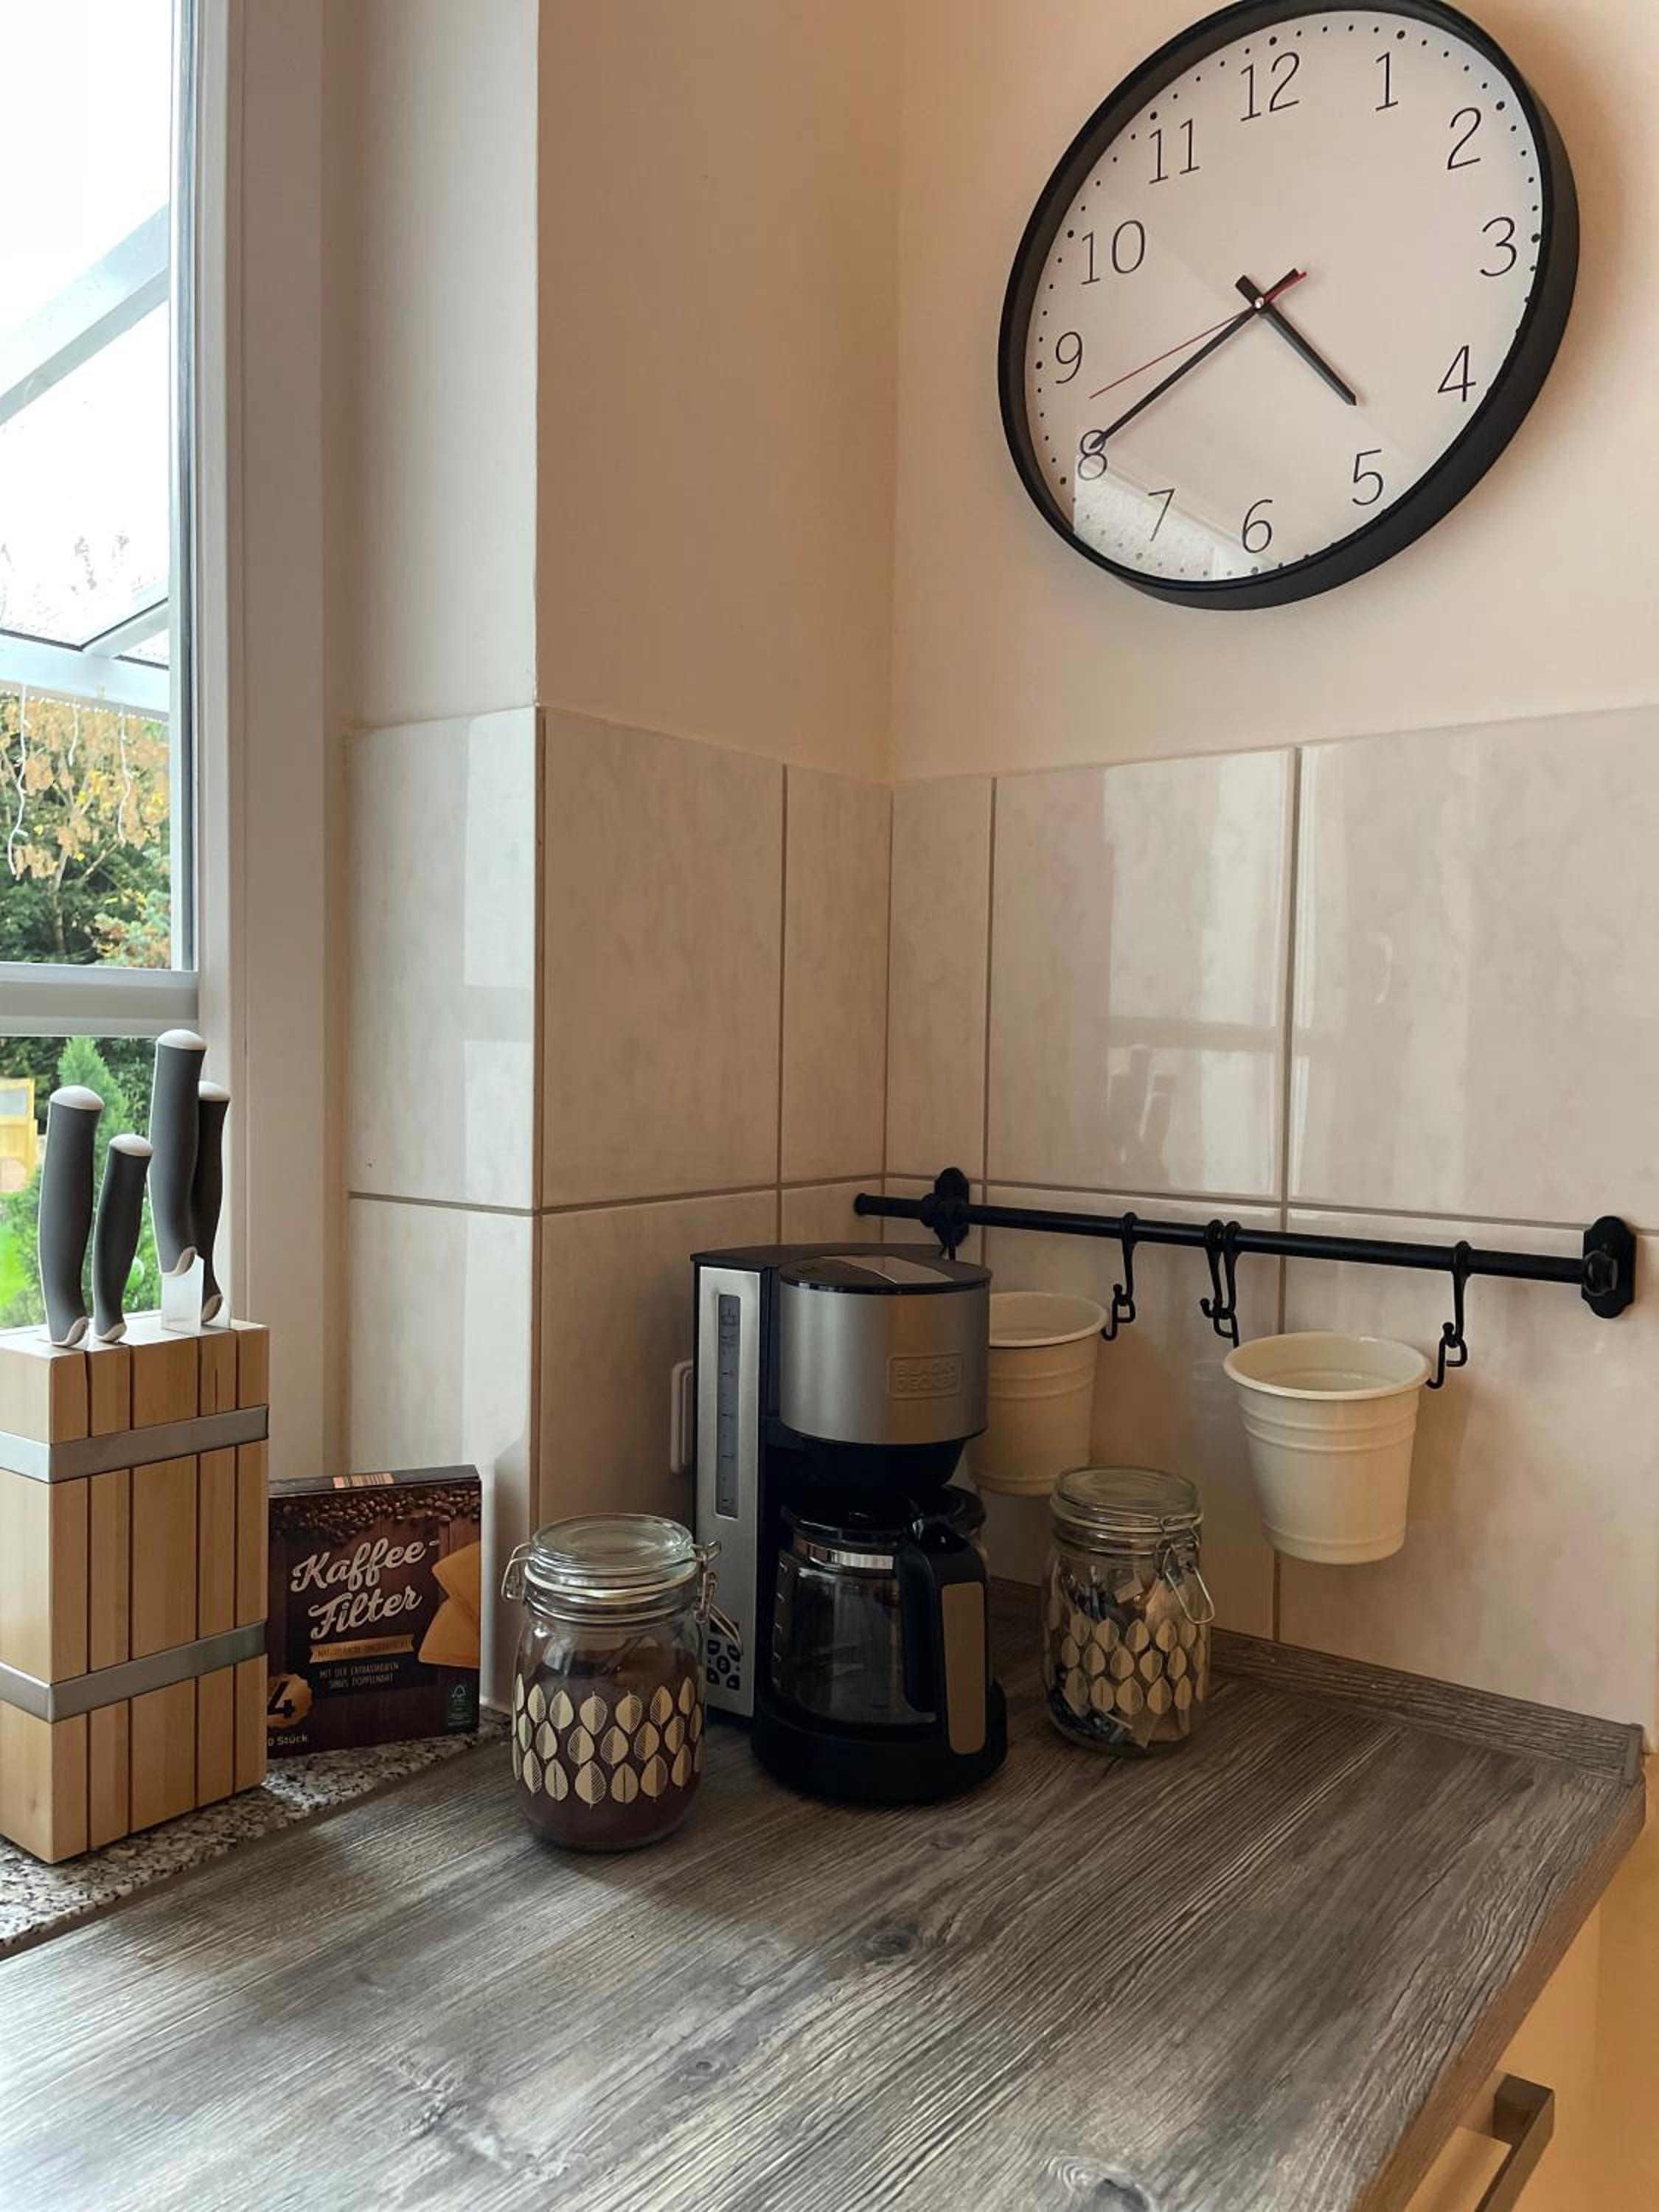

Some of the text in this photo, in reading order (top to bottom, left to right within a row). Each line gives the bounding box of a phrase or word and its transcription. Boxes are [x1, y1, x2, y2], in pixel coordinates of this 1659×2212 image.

[1240, 51, 1300, 122] 12
[1374, 51, 1399, 112] 1
[1148, 117, 1200, 185] 11
[1446, 107, 1482, 171] 2
[1080, 220, 1146, 285] 10
[1479, 216, 1517, 278] 3
[1055, 331, 1083, 384] 9
[1437, 344, 1477, 403] 4
[1077, 429, 1108, 481] 8
[1352, 448, 1384, 507] 5
[1147, 487, 1176, 543] 7
[1241, 498, 1273, 554] 6
[291, 1537, 441, 1593] Kaffee-
[307, 1585, 423, 1640] Filter
[267, 1680, 296, 1719] 4
